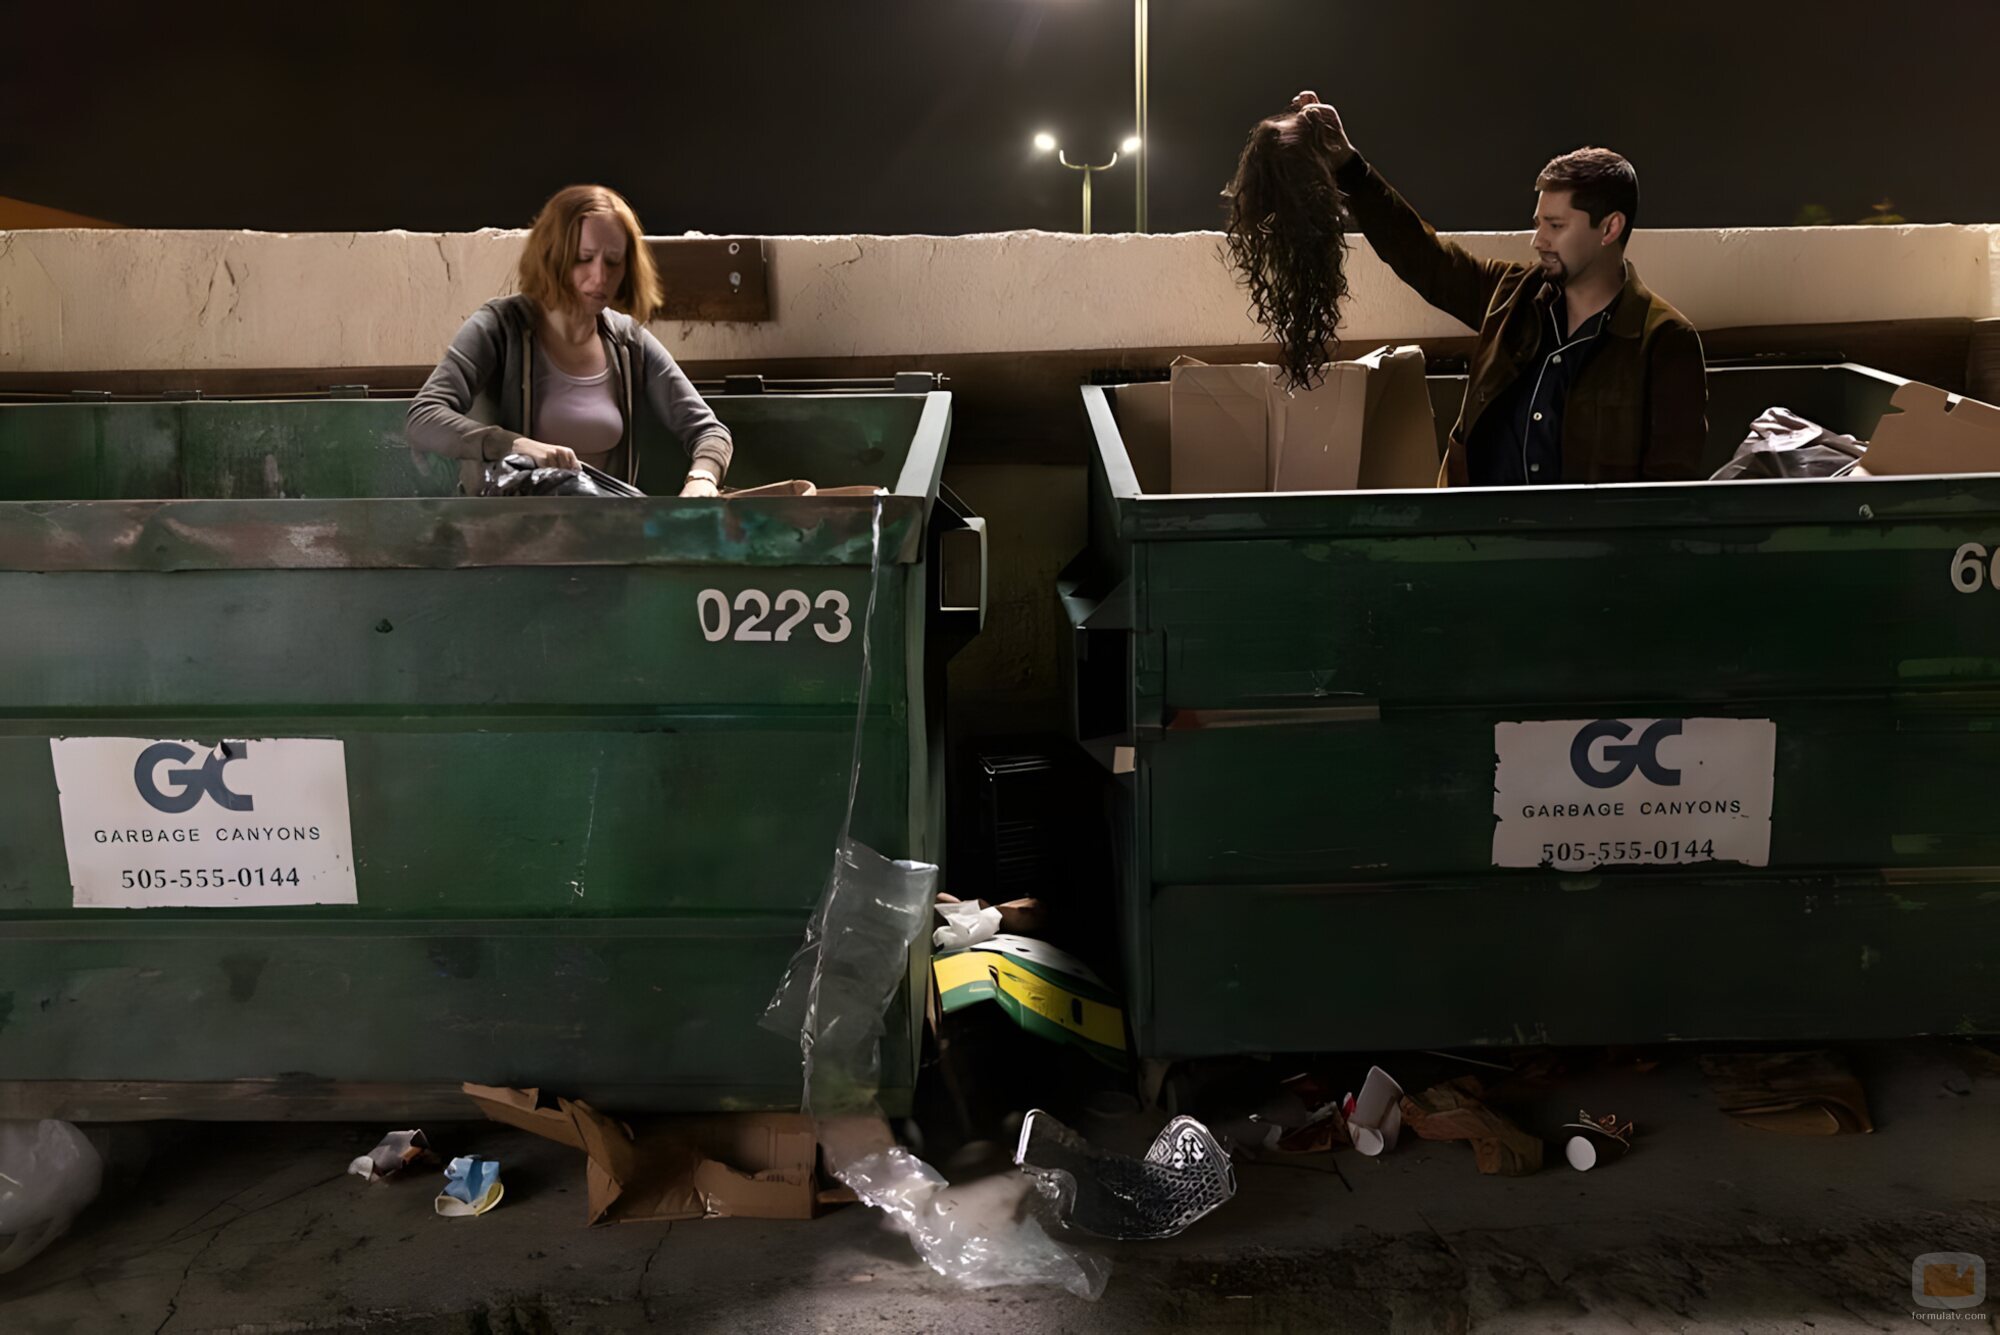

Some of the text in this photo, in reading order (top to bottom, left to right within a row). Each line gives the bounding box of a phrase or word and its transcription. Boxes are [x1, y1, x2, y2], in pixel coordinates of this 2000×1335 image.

[1950, 542, 2000, 593] 6
[696, 588, 852, 643] 0223
[1570, 718, 1682, 789] GC
[133, 741, 254, 814] GC
[1522, 800, 1741, 819] GARBAGE CANYONS
[94, 826, 321, 843] GARBAGE CANYONS
[1542, 839, 1715, 862] 505-555-0144
[121, 867, 300, 889] 505-555-0144
